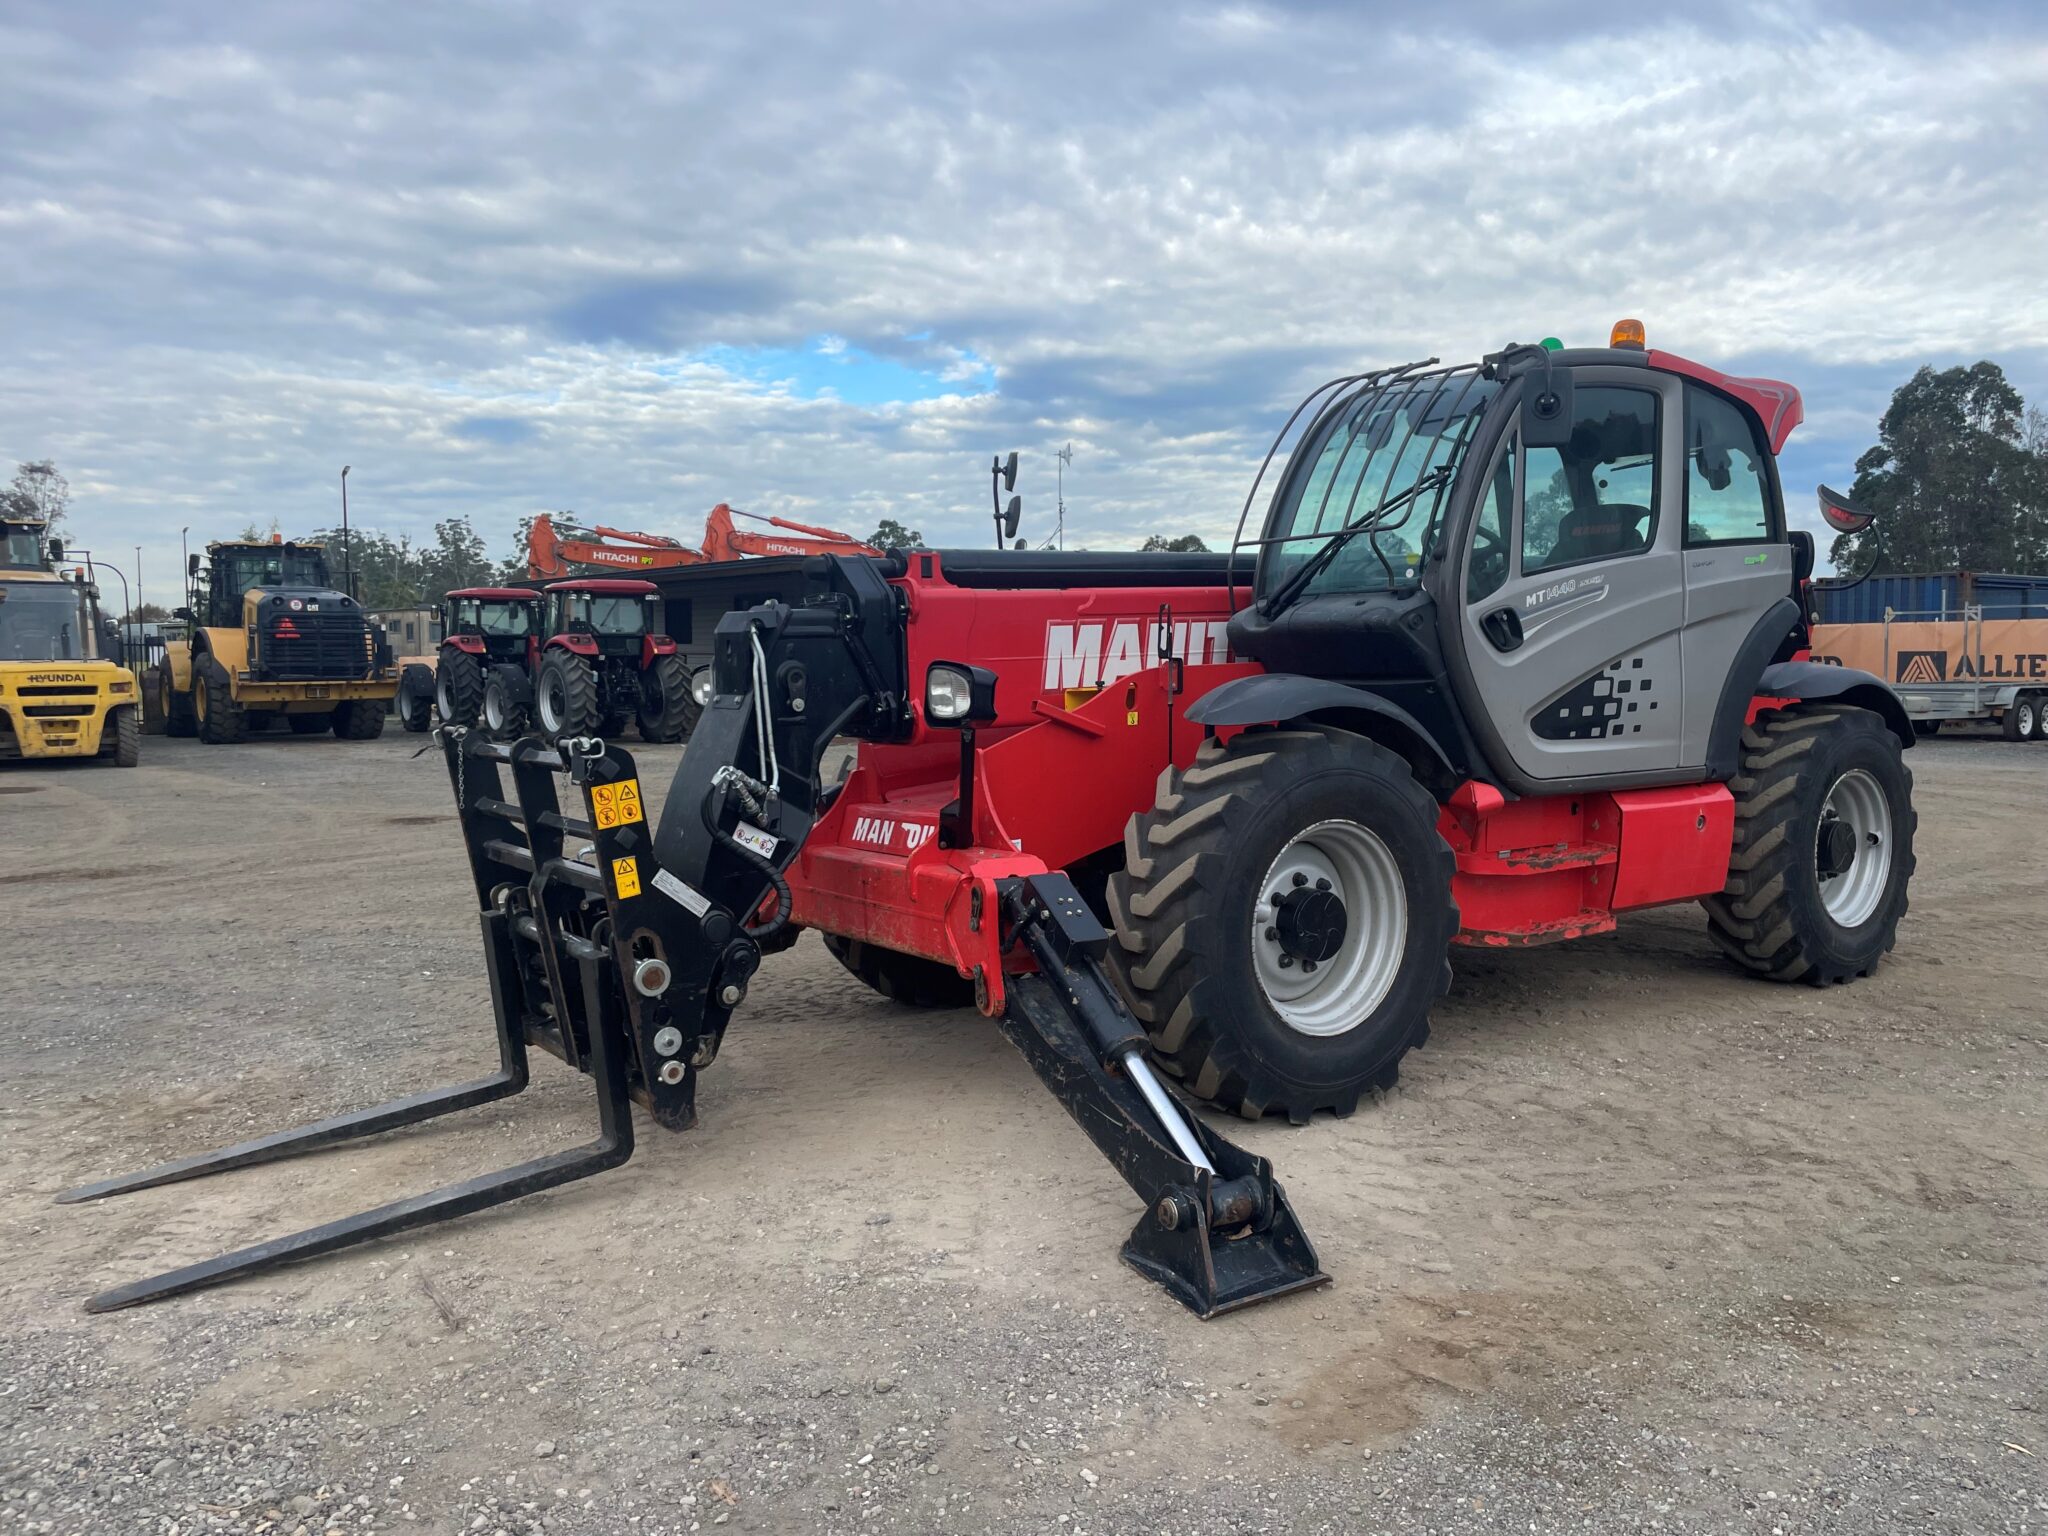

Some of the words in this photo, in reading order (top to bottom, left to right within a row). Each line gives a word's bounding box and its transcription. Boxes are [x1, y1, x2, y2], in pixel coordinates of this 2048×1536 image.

[766, 543, 806, 556] HITACHI
[593, 551, 638, 564] HITACHI
[306, 603, 320, 612] CAT
[1044, 622, 1255, 690] MANIT
[1953, 653, 2047, 678] ALLIE
[27, 673, 86, 683] HYUNDAI
